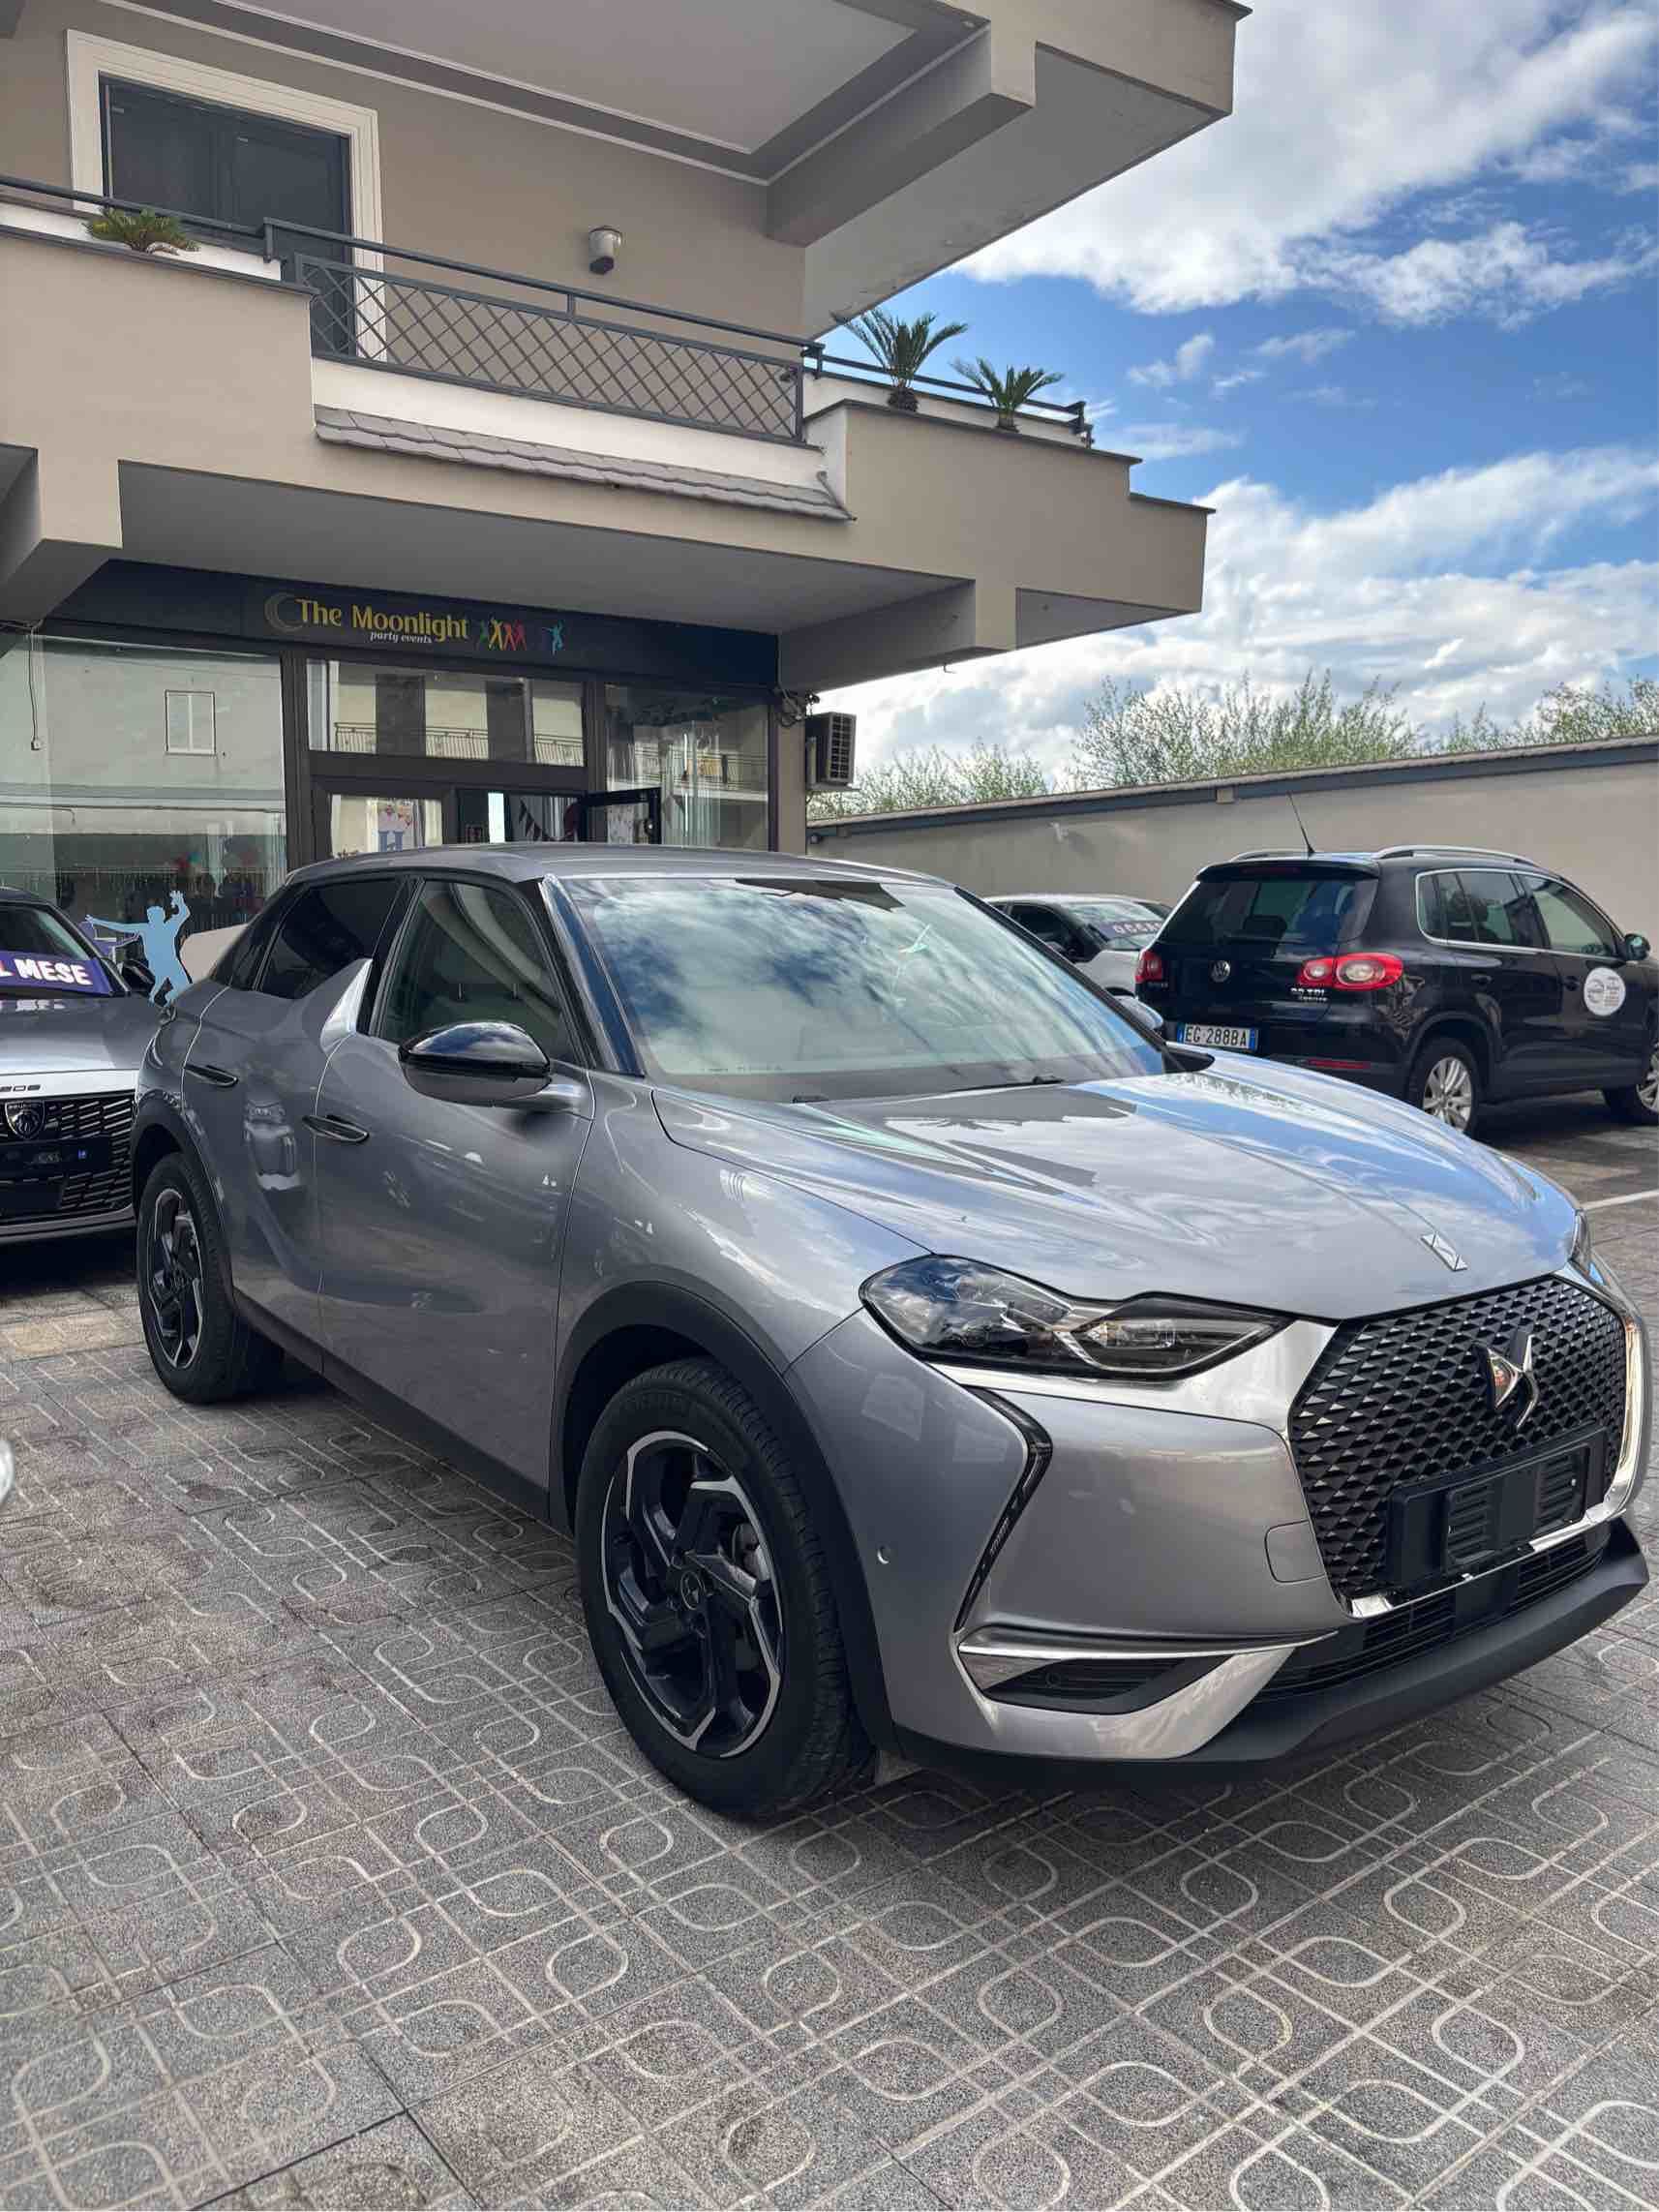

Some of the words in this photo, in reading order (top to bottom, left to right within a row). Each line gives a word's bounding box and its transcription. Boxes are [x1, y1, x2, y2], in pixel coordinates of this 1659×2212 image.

[295, 598, 342, 627] The
[351, 604, 468, 642] Moonlight
[370, 630, 399, 645] party
[401, 634, 433, 645] events
[14, 957, 93, 985] MESE
